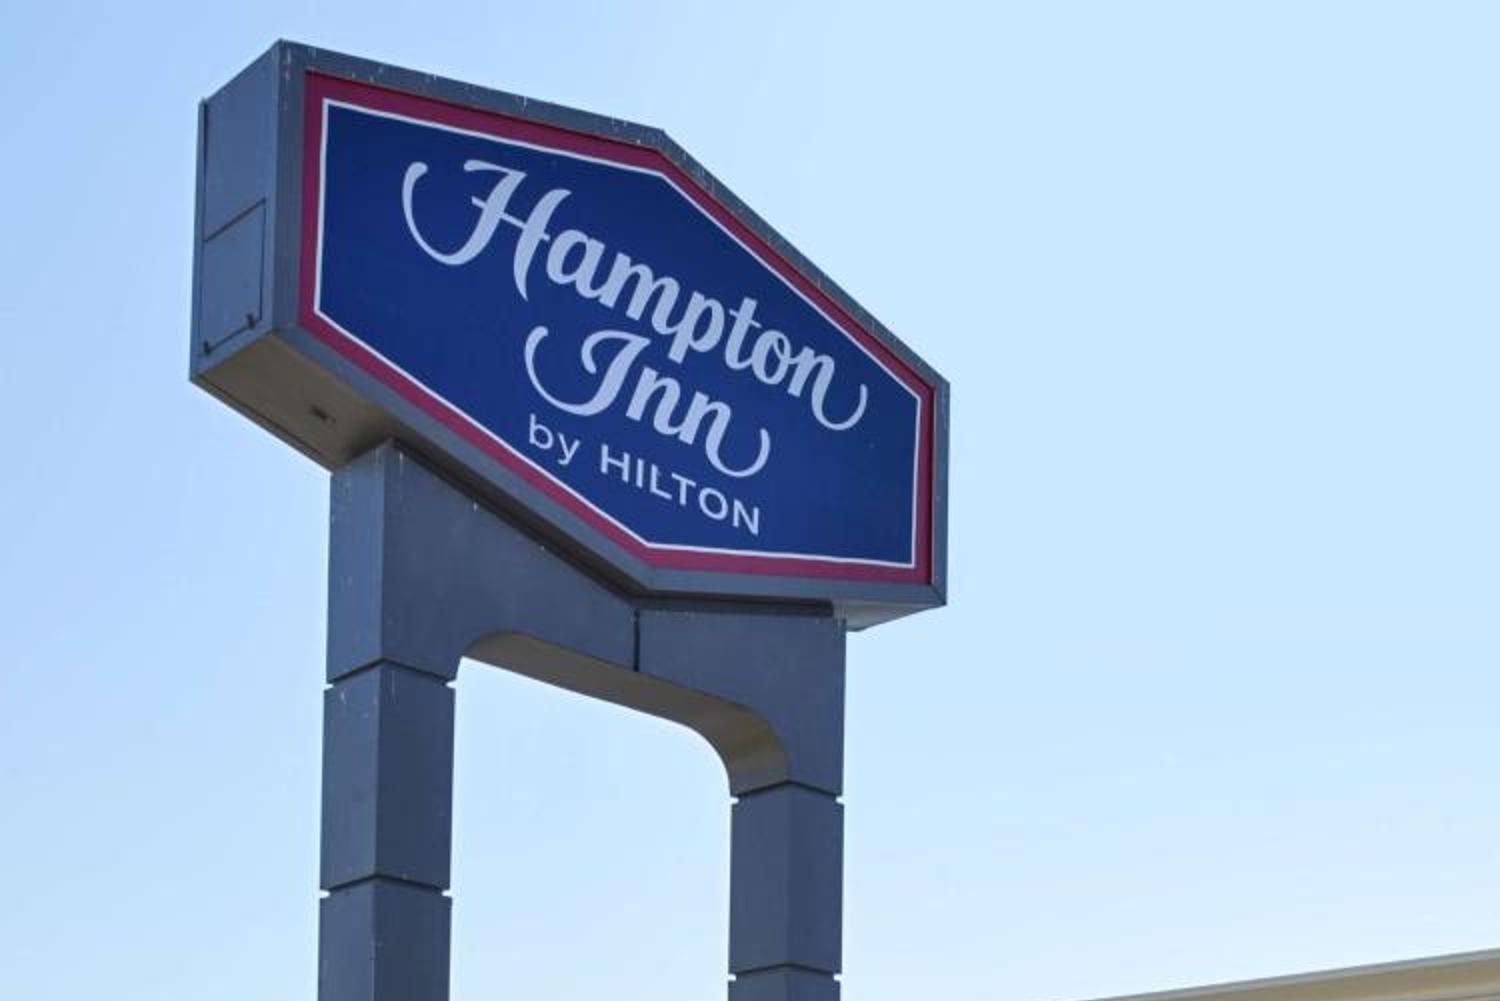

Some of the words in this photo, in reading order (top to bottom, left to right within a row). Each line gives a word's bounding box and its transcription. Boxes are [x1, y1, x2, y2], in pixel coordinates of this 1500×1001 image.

[402, 159, 869, 431] Hampton
[524, 326, 771, 478] Inn
[528, 414, 581, 466] by
[600, 444, 761, 535] HILTON
